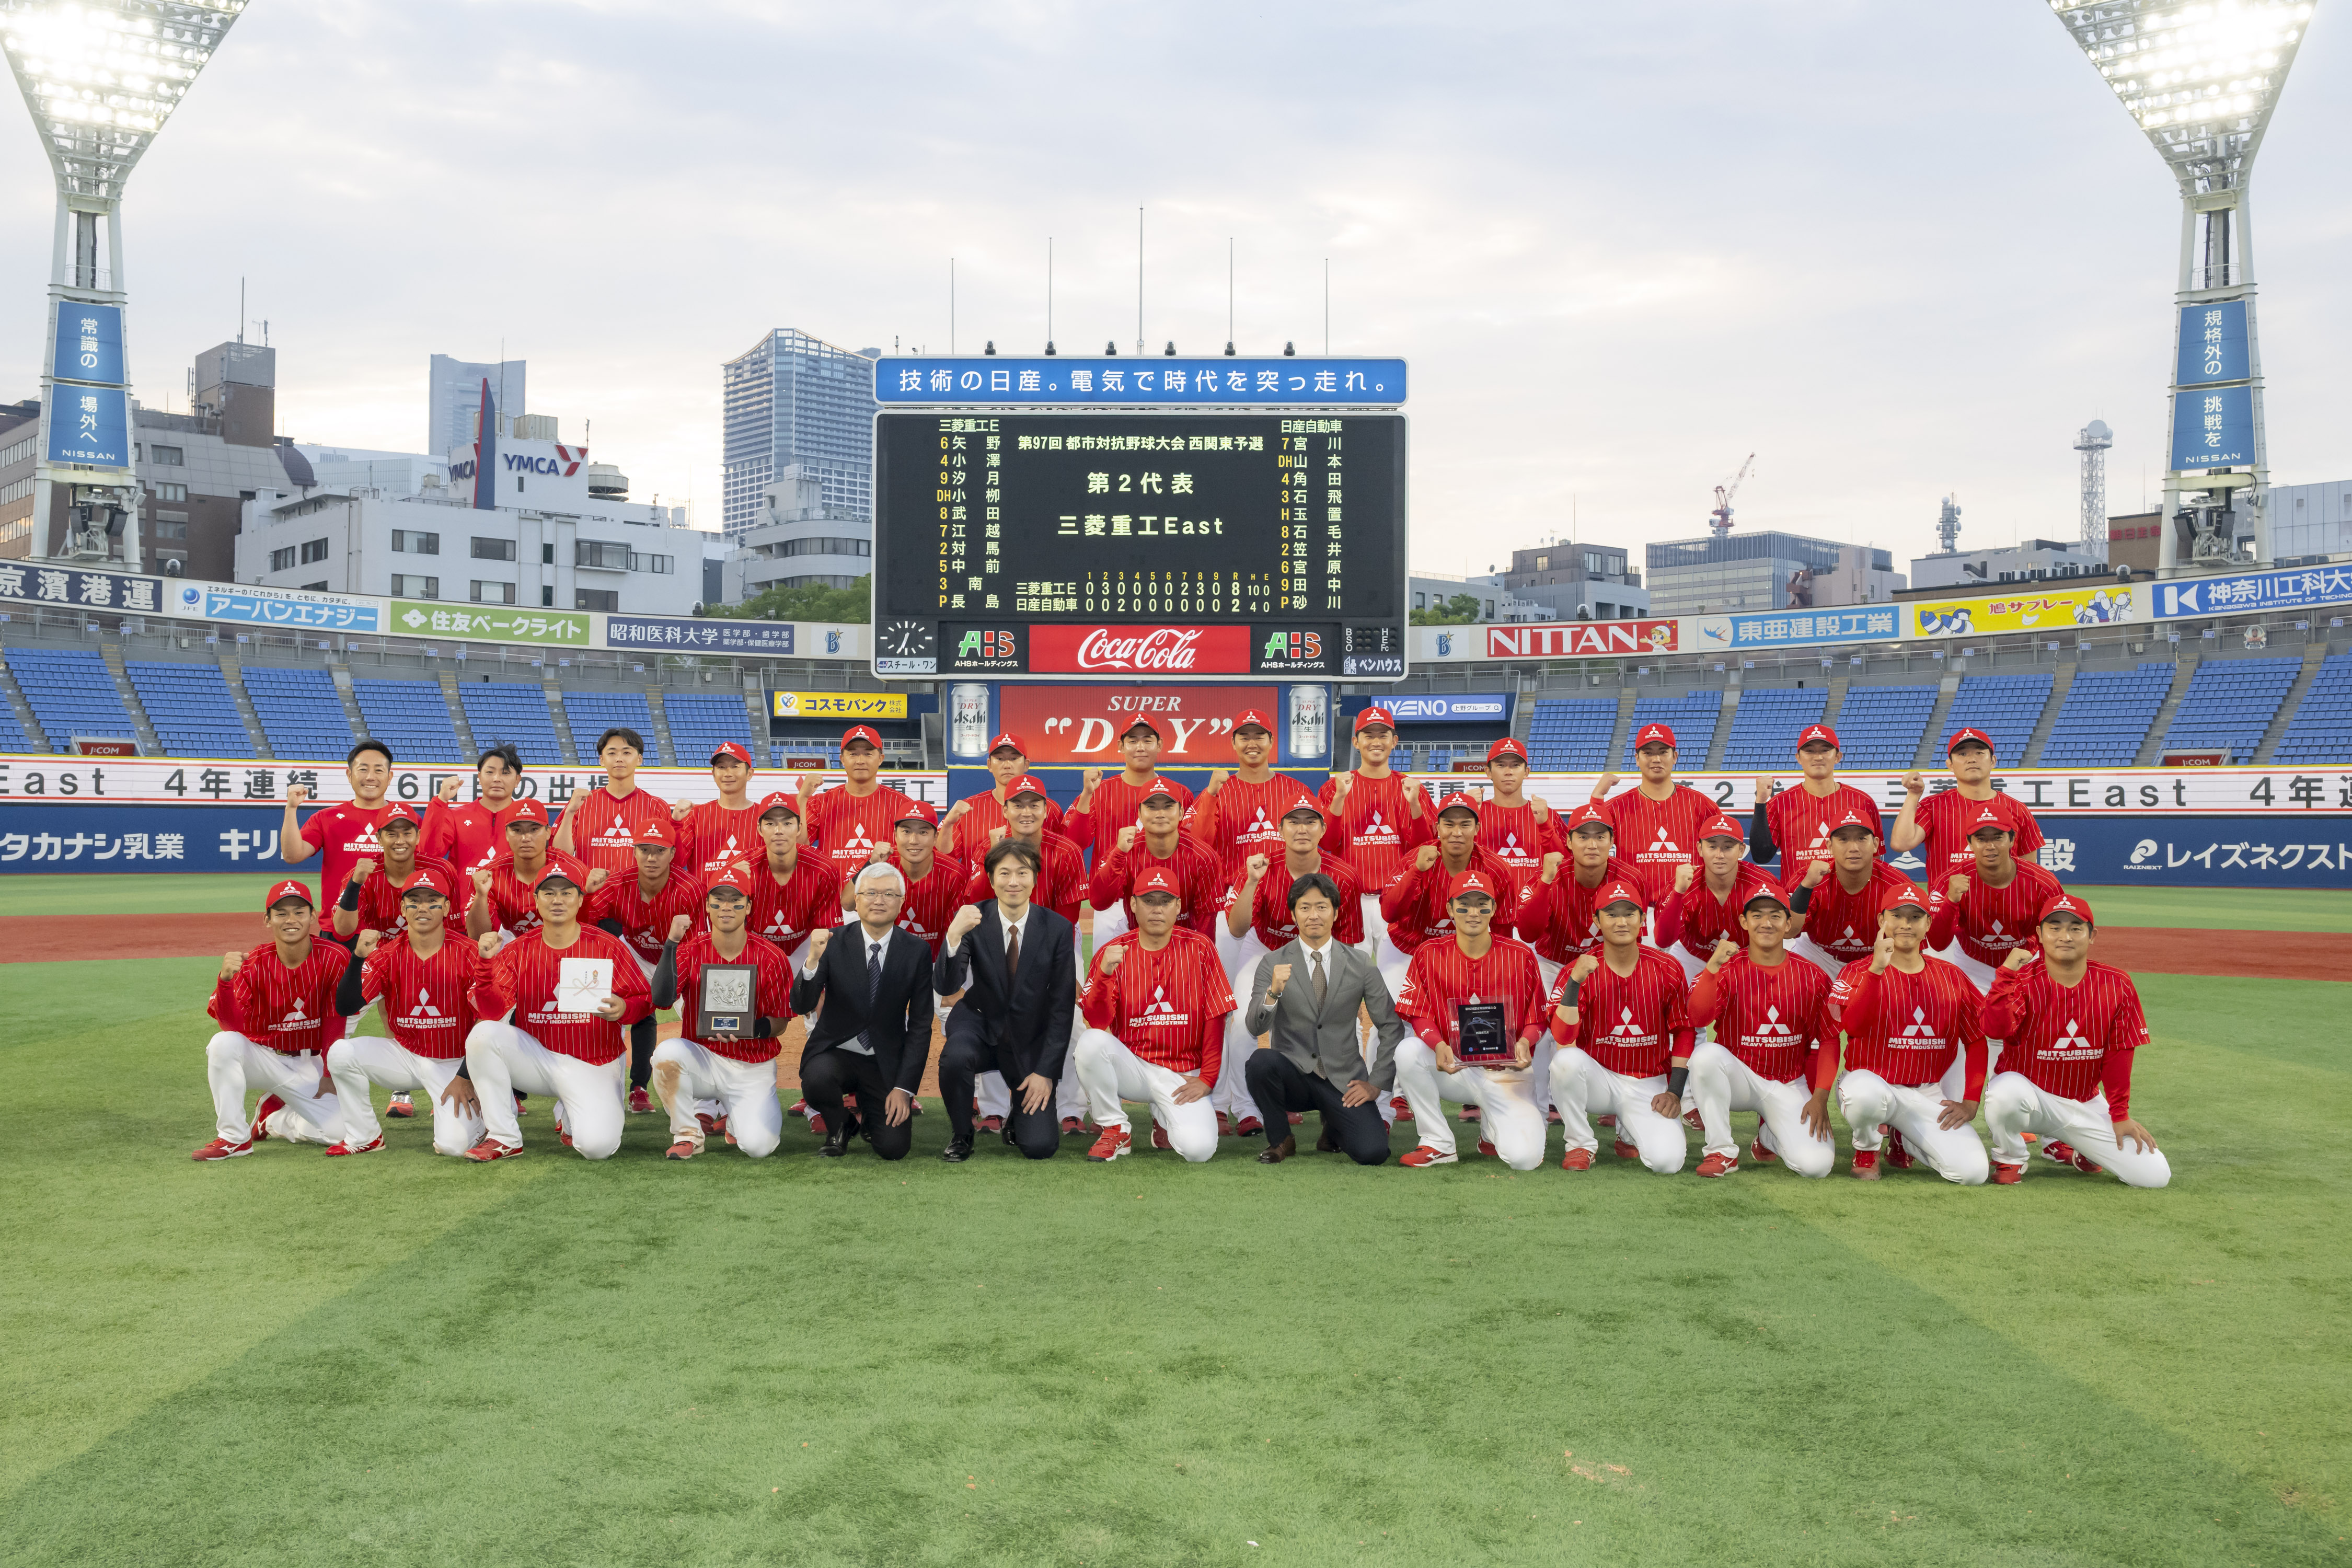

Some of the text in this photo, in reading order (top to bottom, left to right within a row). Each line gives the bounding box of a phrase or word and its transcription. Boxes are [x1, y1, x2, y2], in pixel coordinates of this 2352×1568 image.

[80, 318, 98, 368] 常識の
[2204, 310, 2222, 375] 規格外の
[899, 368, 1385, 393] 技術の日産。電気で時代を突っ走れ。
[80, 396, 98, 443] 場外へ
[939, 418, 999, 433] 三菱重工E
[1281, 419, 1343, 433] 日産自動車
[2204, 396, 2222, 447] 挑戦を
[940, 436, 948, 449] 6
[1018, 435, 1263, 451] 第97回 都市対抗野球大会 西関東予選
[1282, 437, 1289, 450] 7
[62, 449, 115, 460] NISSAN
[940, 454, 949, 467] 4
[1278, 455, 1293, 467] DH
[2186, 453, 2241, 464] NISSAN
[503, 453, 560, 476] YMCA
[940, 471, 948, 485] 9
[1281, 472, 1289, 485] 4
[937, 489, 951, 502] DH
[1281, 490, 1289, 503] 3
[940, 507, 948, 520] 8
[1281, 508, 1289, 521] H
[940, 525, 948, 537] 7
[1057, 514, 1223, 536] 三菱重工East
[1281, 525, 1289, 538] 8
[940, 542, 948, 555] 2
[1281, 543, 1289, 556] 2
[940, 560, 947, 572] 5
[1281, 561, 1289, 573] 6
[1088, 571, 1091, 580] 1
[1103, 571, 1108, 580] 2
[1119, 571, 1124, 580] 3
[1134, 572, 1140, 580] 4
[1150, 572, 1156, 580] 5
[1166, 572, 1171, 580] 6
[1182, 572, 1187, 580] 7
[1198, 572, 1203, 580] 8
[1214, 572, 1219, 580] 9
[1233, 572, 1238, 580] R
[939, 576, 983, 591] 3 南
[1016, 581, 1270, 596] 三菱重工E 0 3 0 0 0 0 2 3 0 8 10 0
[1281, 579, 1289, 591] 9
[2208, 569, 2352, 604] 神奈川工科大
[939, 595, 947, 607] P
[1017, 597, 1078, 612] 日産自動車
[1281, 596, 1289, 609] P
[1989, 598, 2073, 615] 鳩サブレー
[2260, 597, 2302, 607] INSTITUTE
[212, 597, 376, 626] アーバンエナジー
[431, 610, 581, 639] 住友ベークライト
[1739, 612, 1893, 642] 東亜建設工業
[610, 624, 718, 645] 昭和医科大学
[723, 629, 789, 638] 医学部・歯学部
[1490, 625, 1638, 655] NITTAN
[723, 638, 789, 648] 薬学部・保健医療学部
[1078, 629, 1204, 671] Coca-Cola
[887, 660, 937, 670] スチール・ワン
[805, 699, 887, 713] コスモバンク
[1108, 696, 1181, 711] SUPER
[954, 710, 986, 724] Asahi
[1292, 711, 1324, 725] Asahi
[1045, 717, 1233, 753] “DY”
[88, 746, 120, 756] J:COM
[0, 832, 184, 861] タカナシ乳業
[220, 828, 285, 861] キリ
[2168, 841, 2352, 870] レイズネクスト
[396, 1016, 456, 1025] MITSUBISHI
[528, 1012, 591, 1021] MITSUBISHI
[1129, 1014, 1188, 1023] MITSUBISHI
[1888, 1037, 1946, 1045] MITSUBISHI
